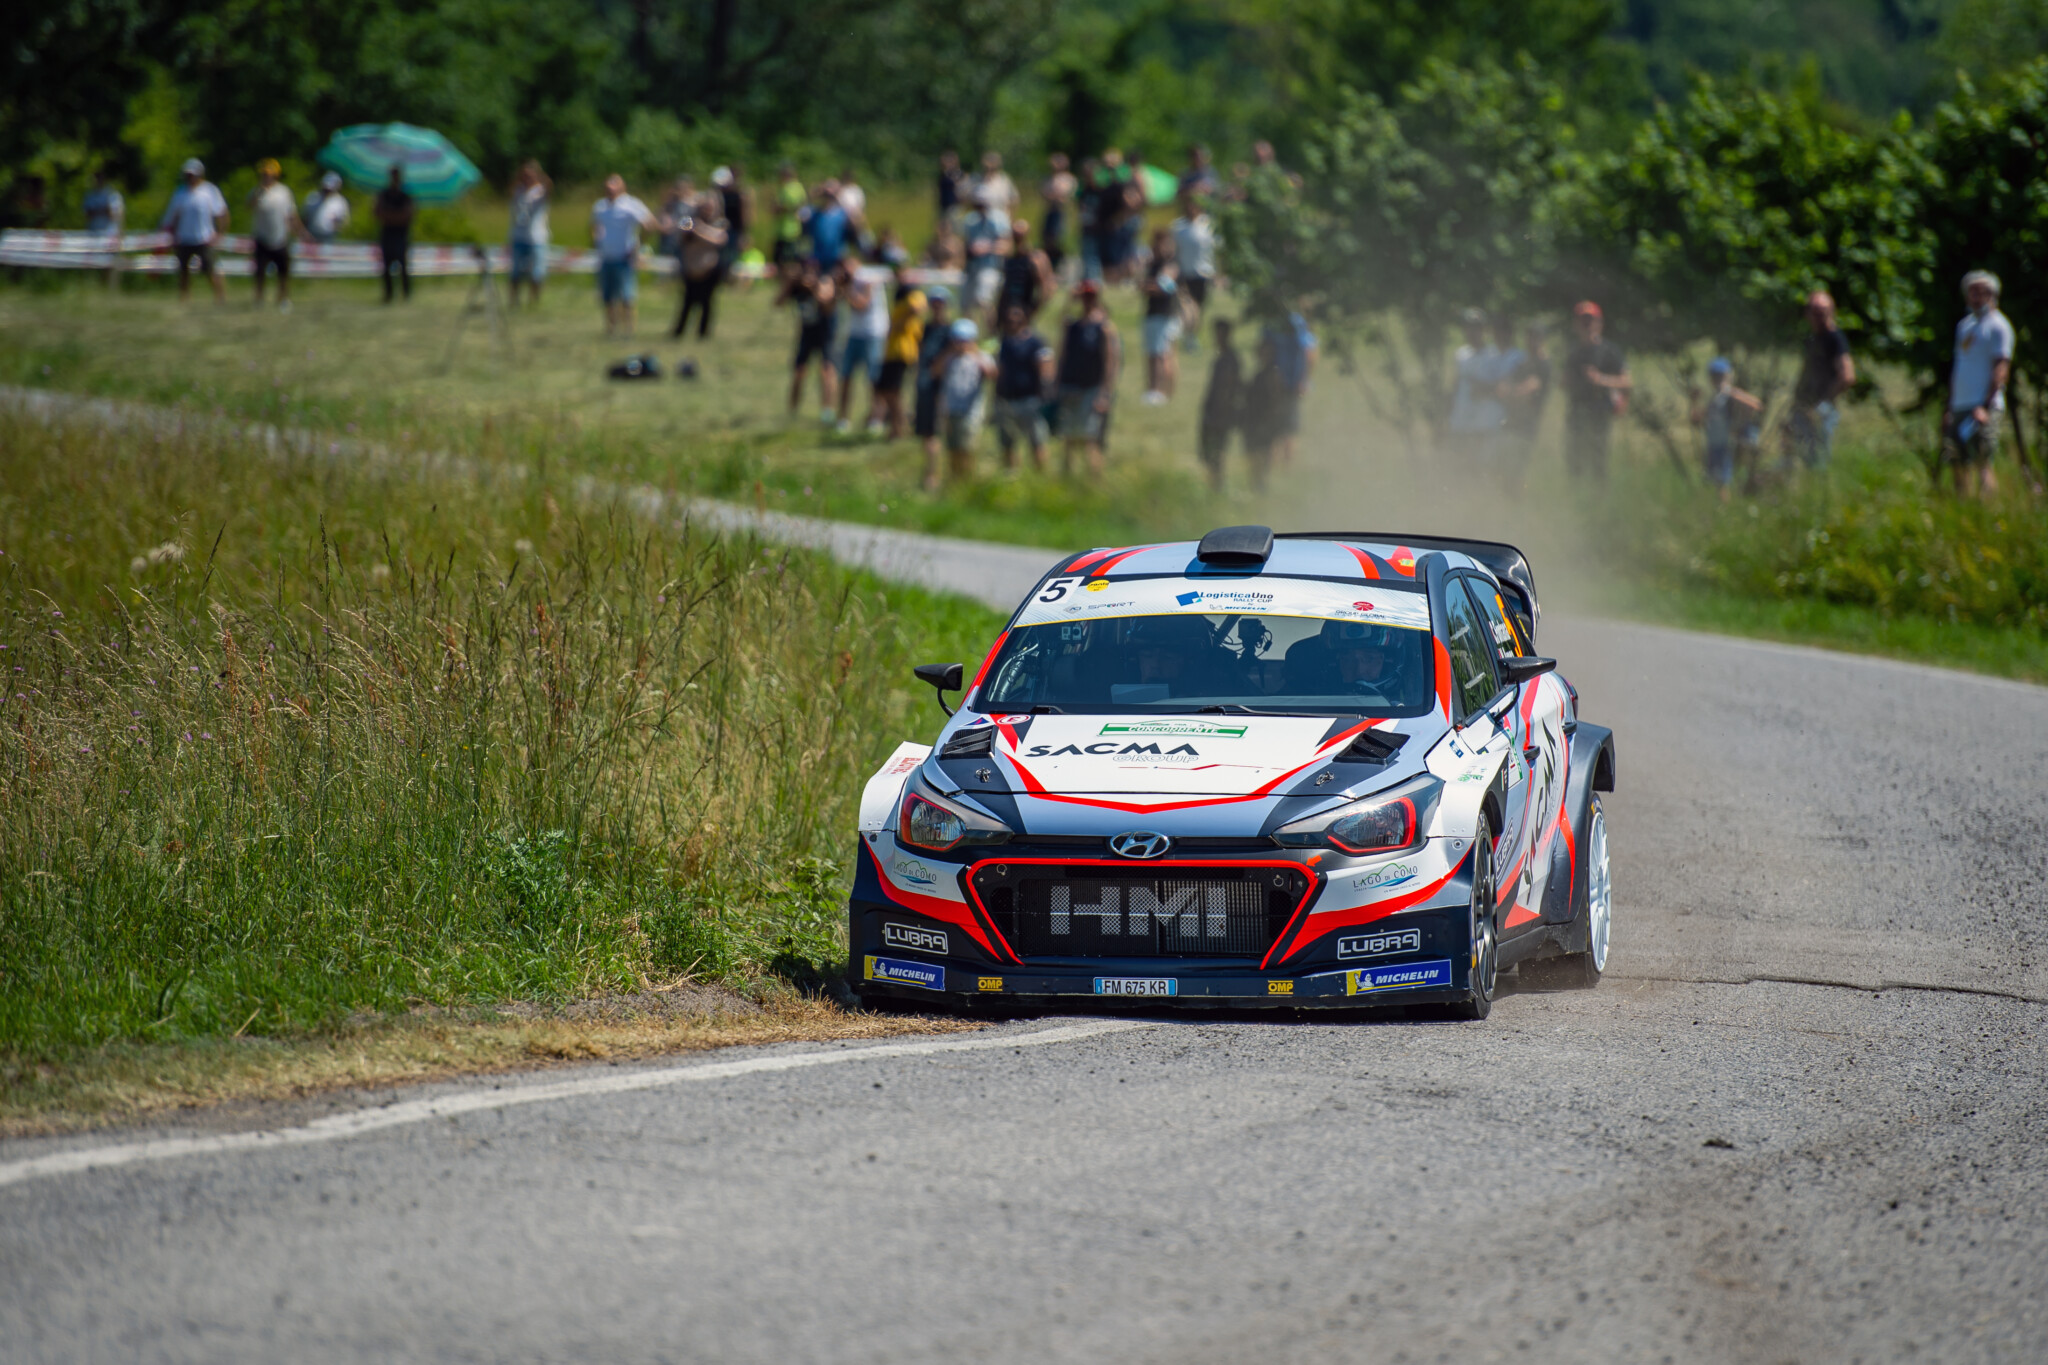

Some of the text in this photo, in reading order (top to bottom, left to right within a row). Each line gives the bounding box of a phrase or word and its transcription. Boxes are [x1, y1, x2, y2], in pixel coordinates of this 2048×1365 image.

[1039, 579, 1074, 603] 5
[1024, 742, 1200, 758] SACMA
[1112, 755, 1200, 763] GROUP
[1352, 874, 1382, 889] LAGO
[1393, 865, 1418, 879] COMO
[1050, 885, 1227, 937] HMI
[886, 927, 947, 950] LUBRA
[1340, 933, 1418, 954] LUBRA
[888, 967, 936, 982] MICHELIN
[1375, 970, 1439, 985] MICHELIN
[978, 980, 1003, 989] OMP
[1104, 980, 1167, 995] FM 675 KR
[1267, 982, 1294, 993] OMP
